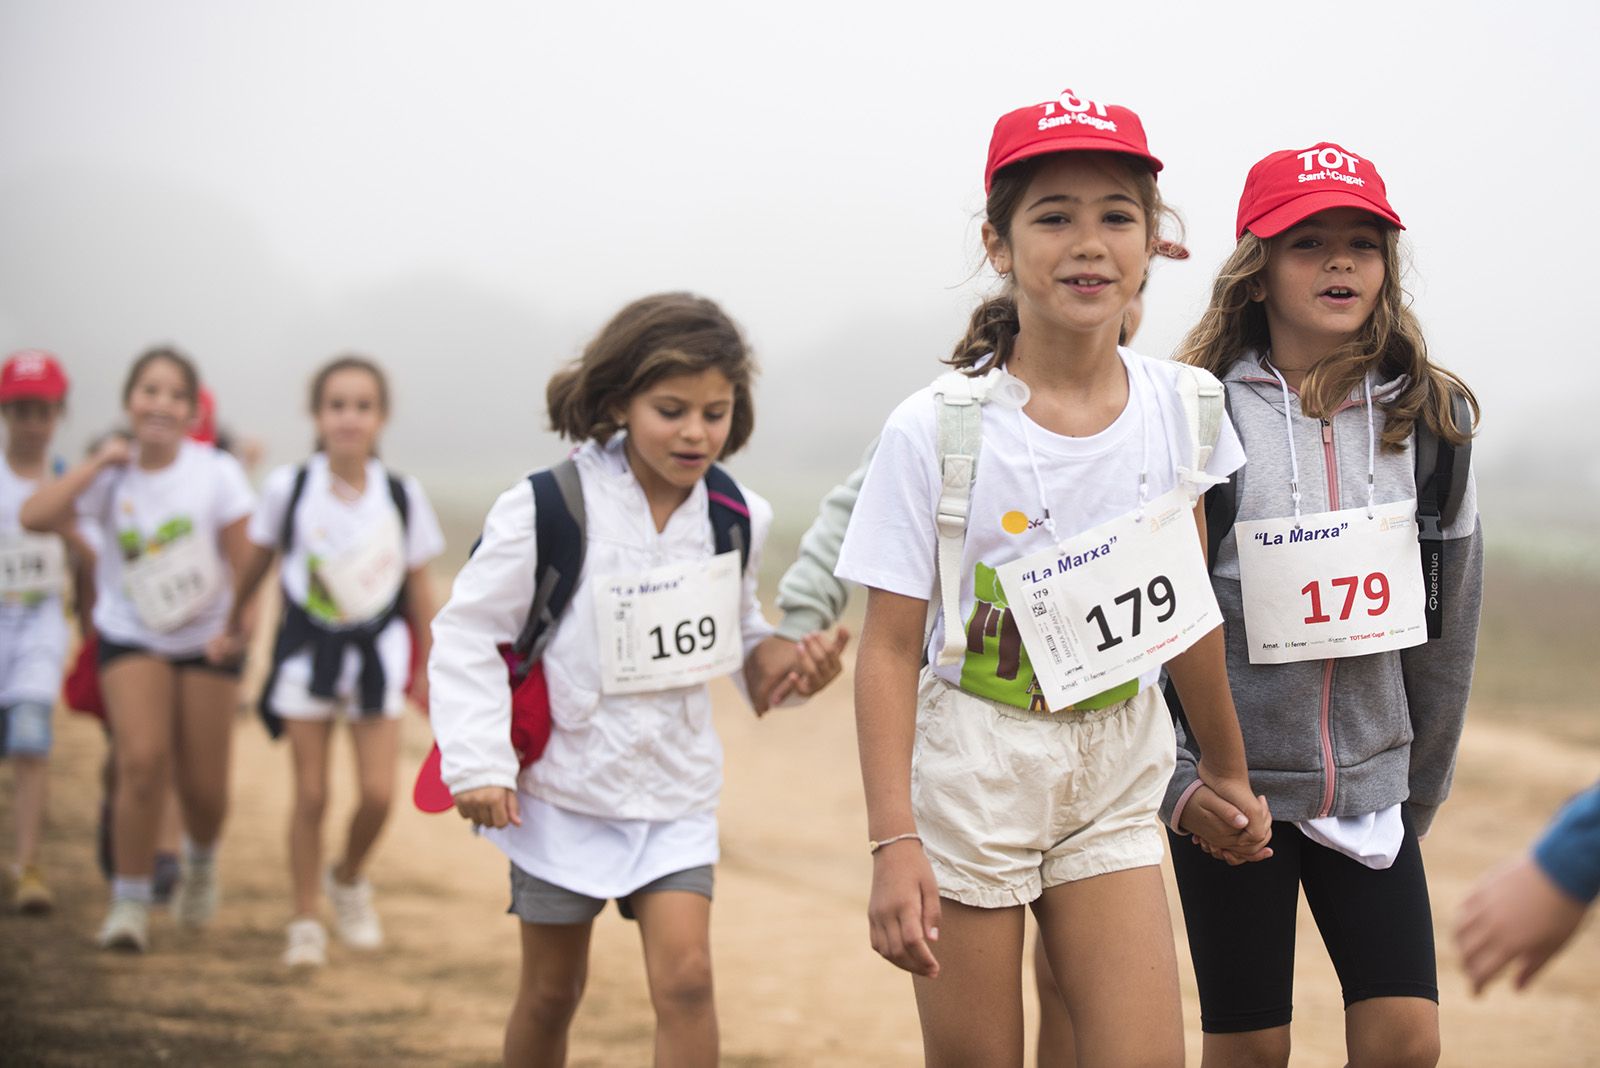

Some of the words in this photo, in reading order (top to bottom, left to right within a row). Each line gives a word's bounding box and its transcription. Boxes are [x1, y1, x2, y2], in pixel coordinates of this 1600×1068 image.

[1037, 114, 1072, 131] Sant
[1077, 113, 1117, 132] Cugat
[1297, 147, 1360, 174] TOT
[1298, 170, 1326, 183] Sant
[1332, 170, 1366, 188] Cugat
[1032, 588, 1049, 600] 179
[1300, 571, 1391, 625] 179
[1428, 552, 1439, 611] Quechua
[1086, 574, 1177, 652] 179
[649, 616, 717, 660] 169
